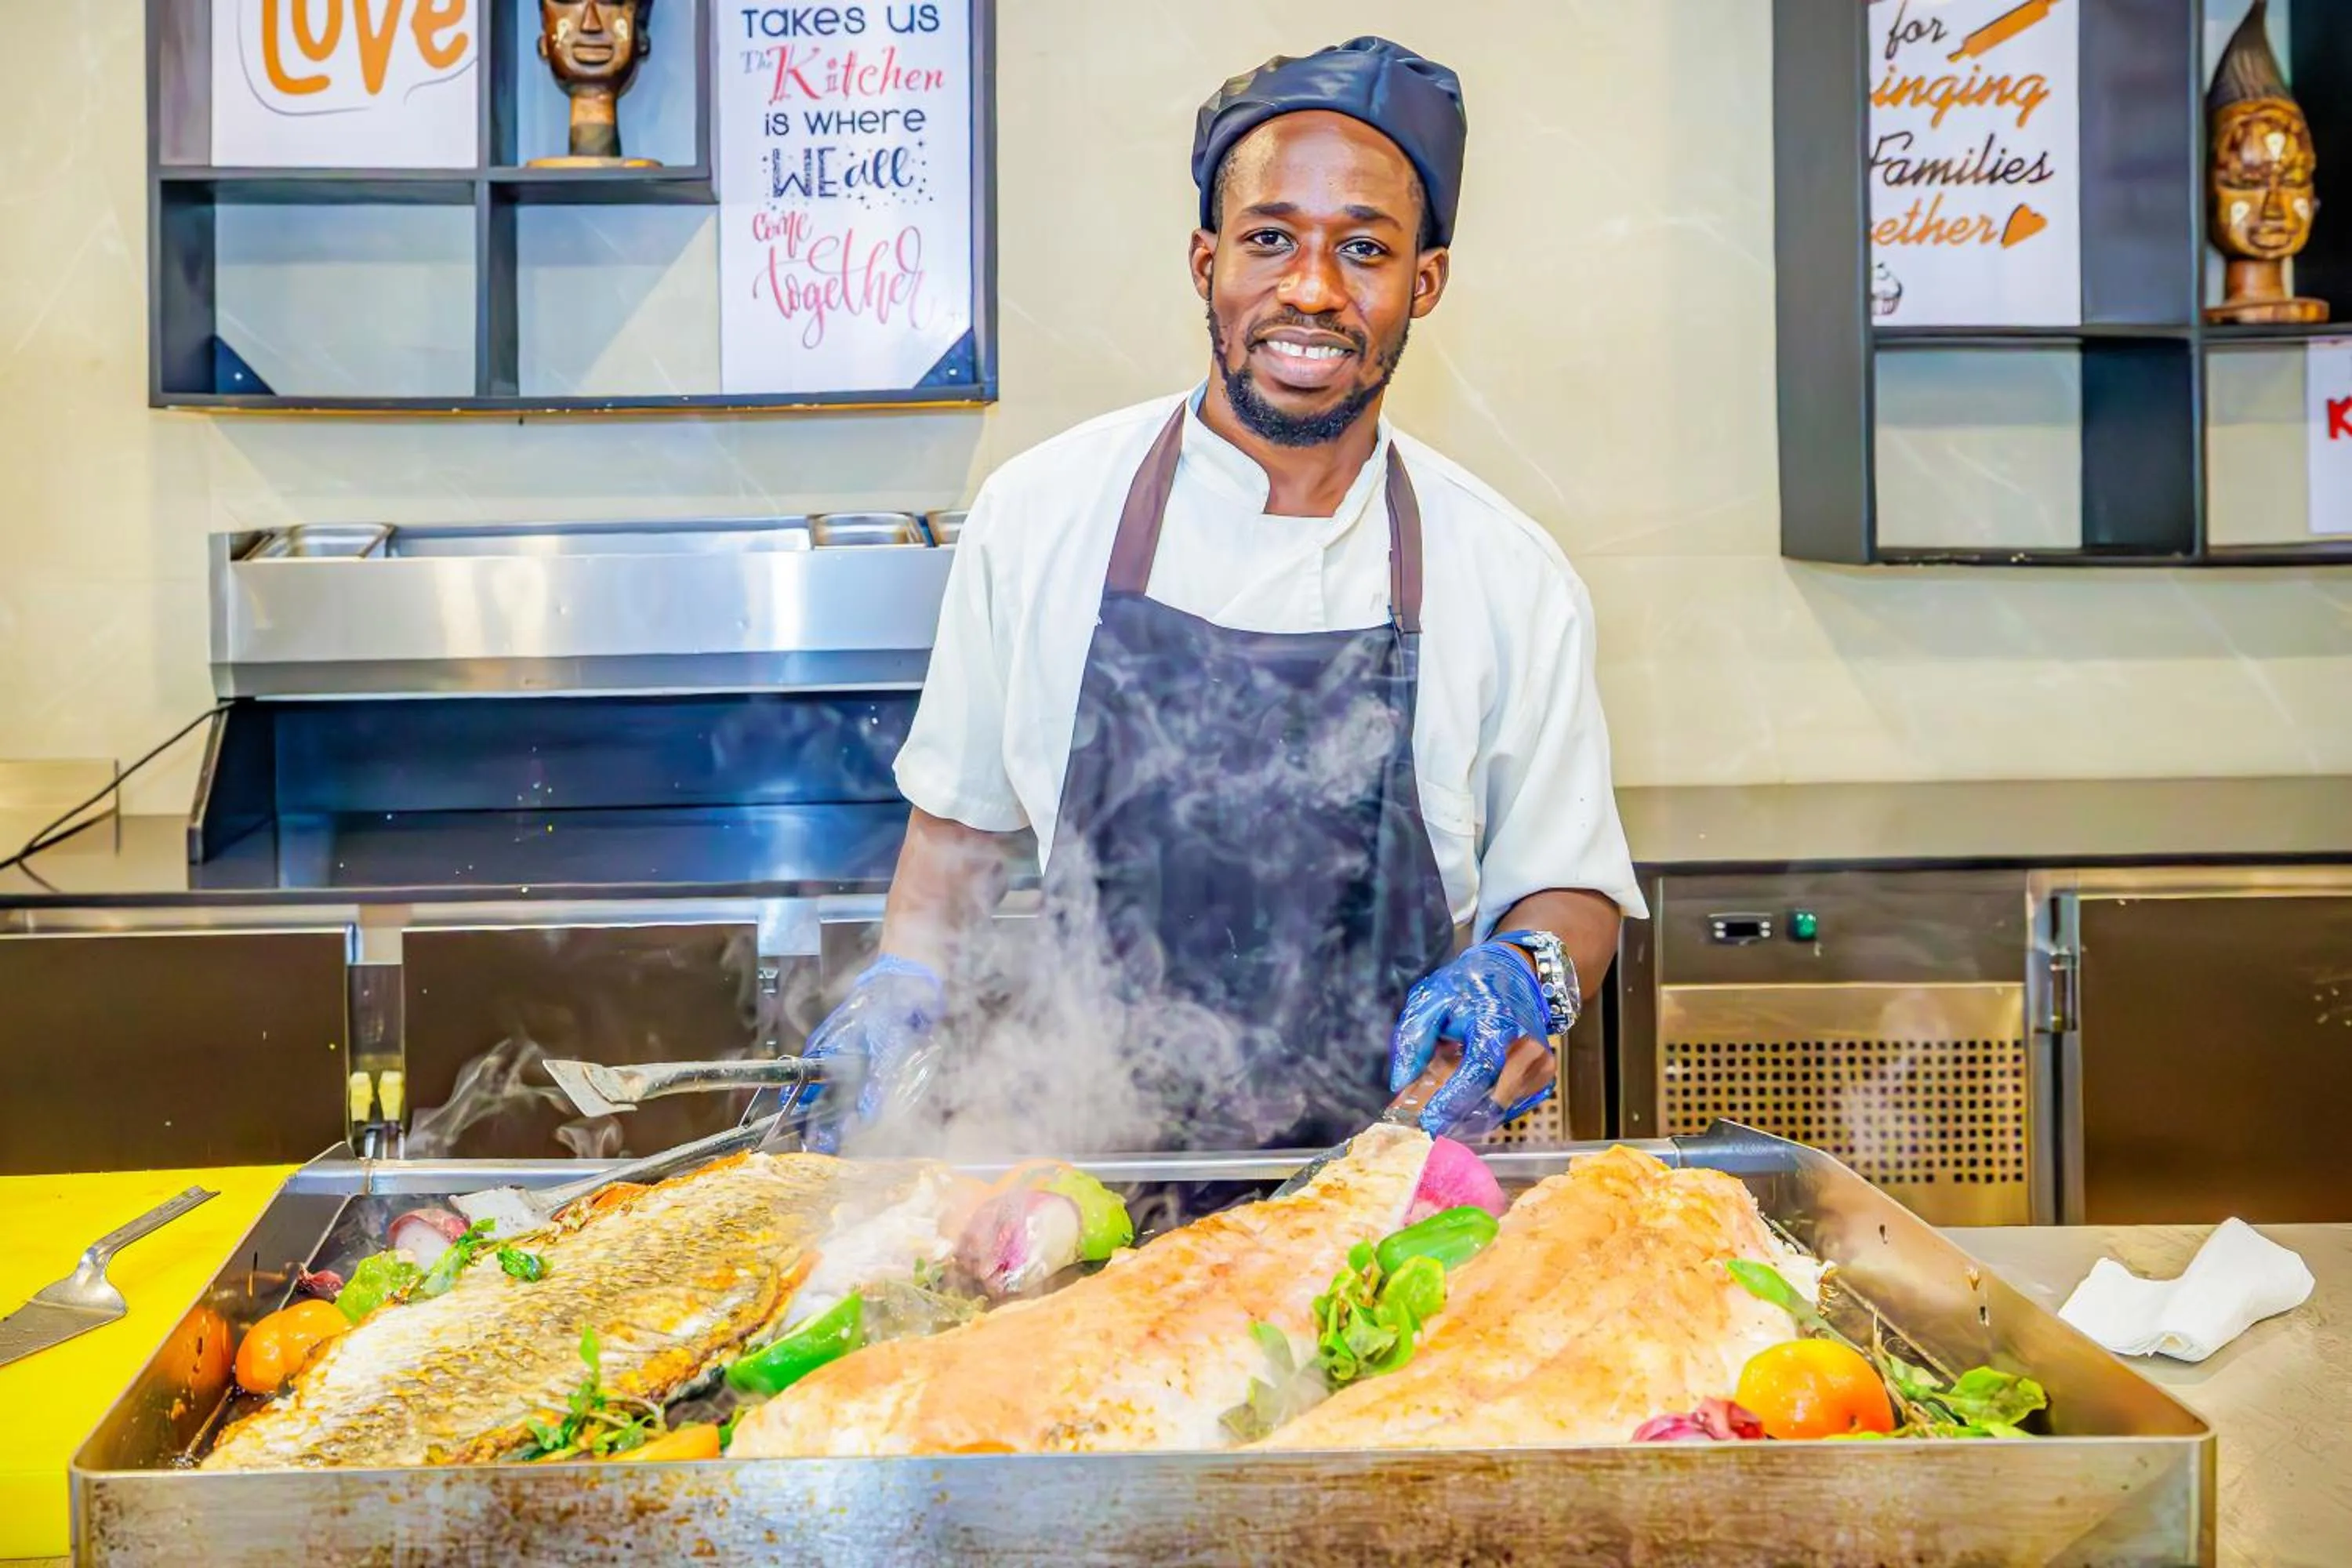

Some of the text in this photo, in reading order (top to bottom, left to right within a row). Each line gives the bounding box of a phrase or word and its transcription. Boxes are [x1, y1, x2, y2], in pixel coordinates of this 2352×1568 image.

[887, 4, 941, 33] us
[1885, 0, 1949, 60] for
[767, 43, 946, 106] Kitchen
[1869, 64, 2050, 129] inging
[764, 112, 790, 136] is
[771, 147, 914, 198] WE all
[1869, 131, 2054, 186] Families
[753, 210, 813, 259] come
[1871, 192, 1998, 246] ether
[753, 225, 938, 350] together
